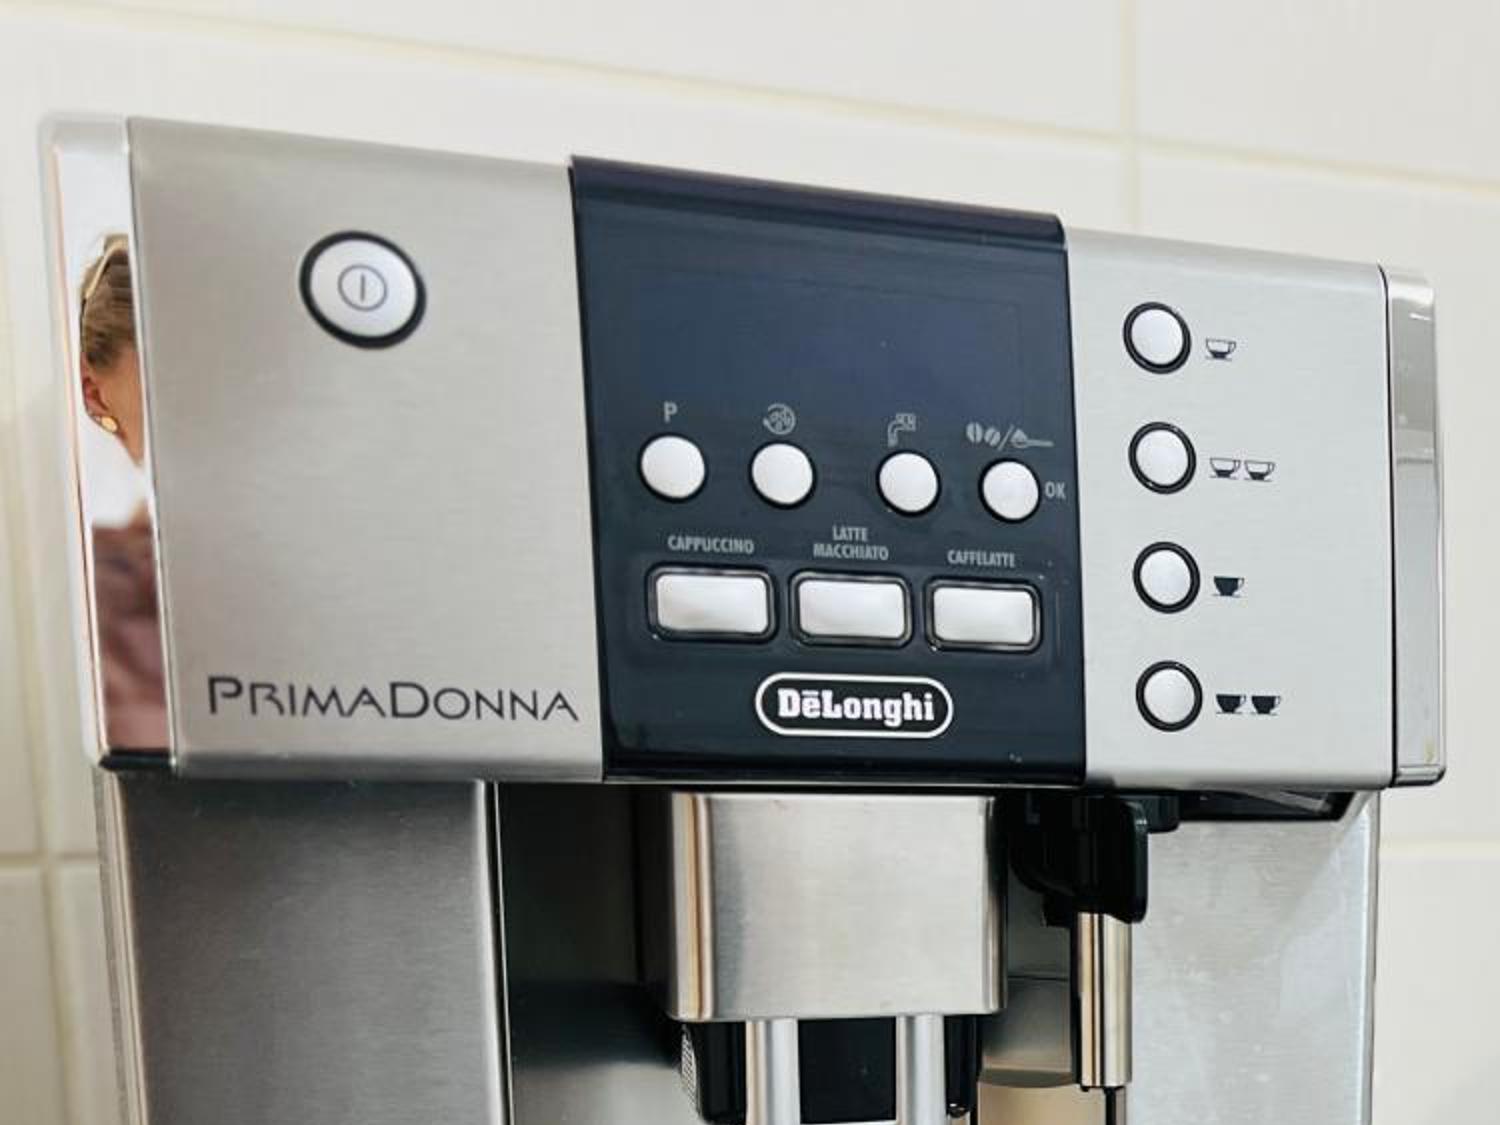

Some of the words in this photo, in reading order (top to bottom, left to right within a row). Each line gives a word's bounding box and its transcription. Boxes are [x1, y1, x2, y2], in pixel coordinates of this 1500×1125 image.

[664, 402, 678, 422] P
[1045, 482, 1066, 499] OK
[832, 526, 868, 542] LATTE
[668, 535, 755, 554] CAPPUCCINO
[813, 543, 889, 561] MACCHIATO
[947, 549, 1015, 568] CAFFELATTE
